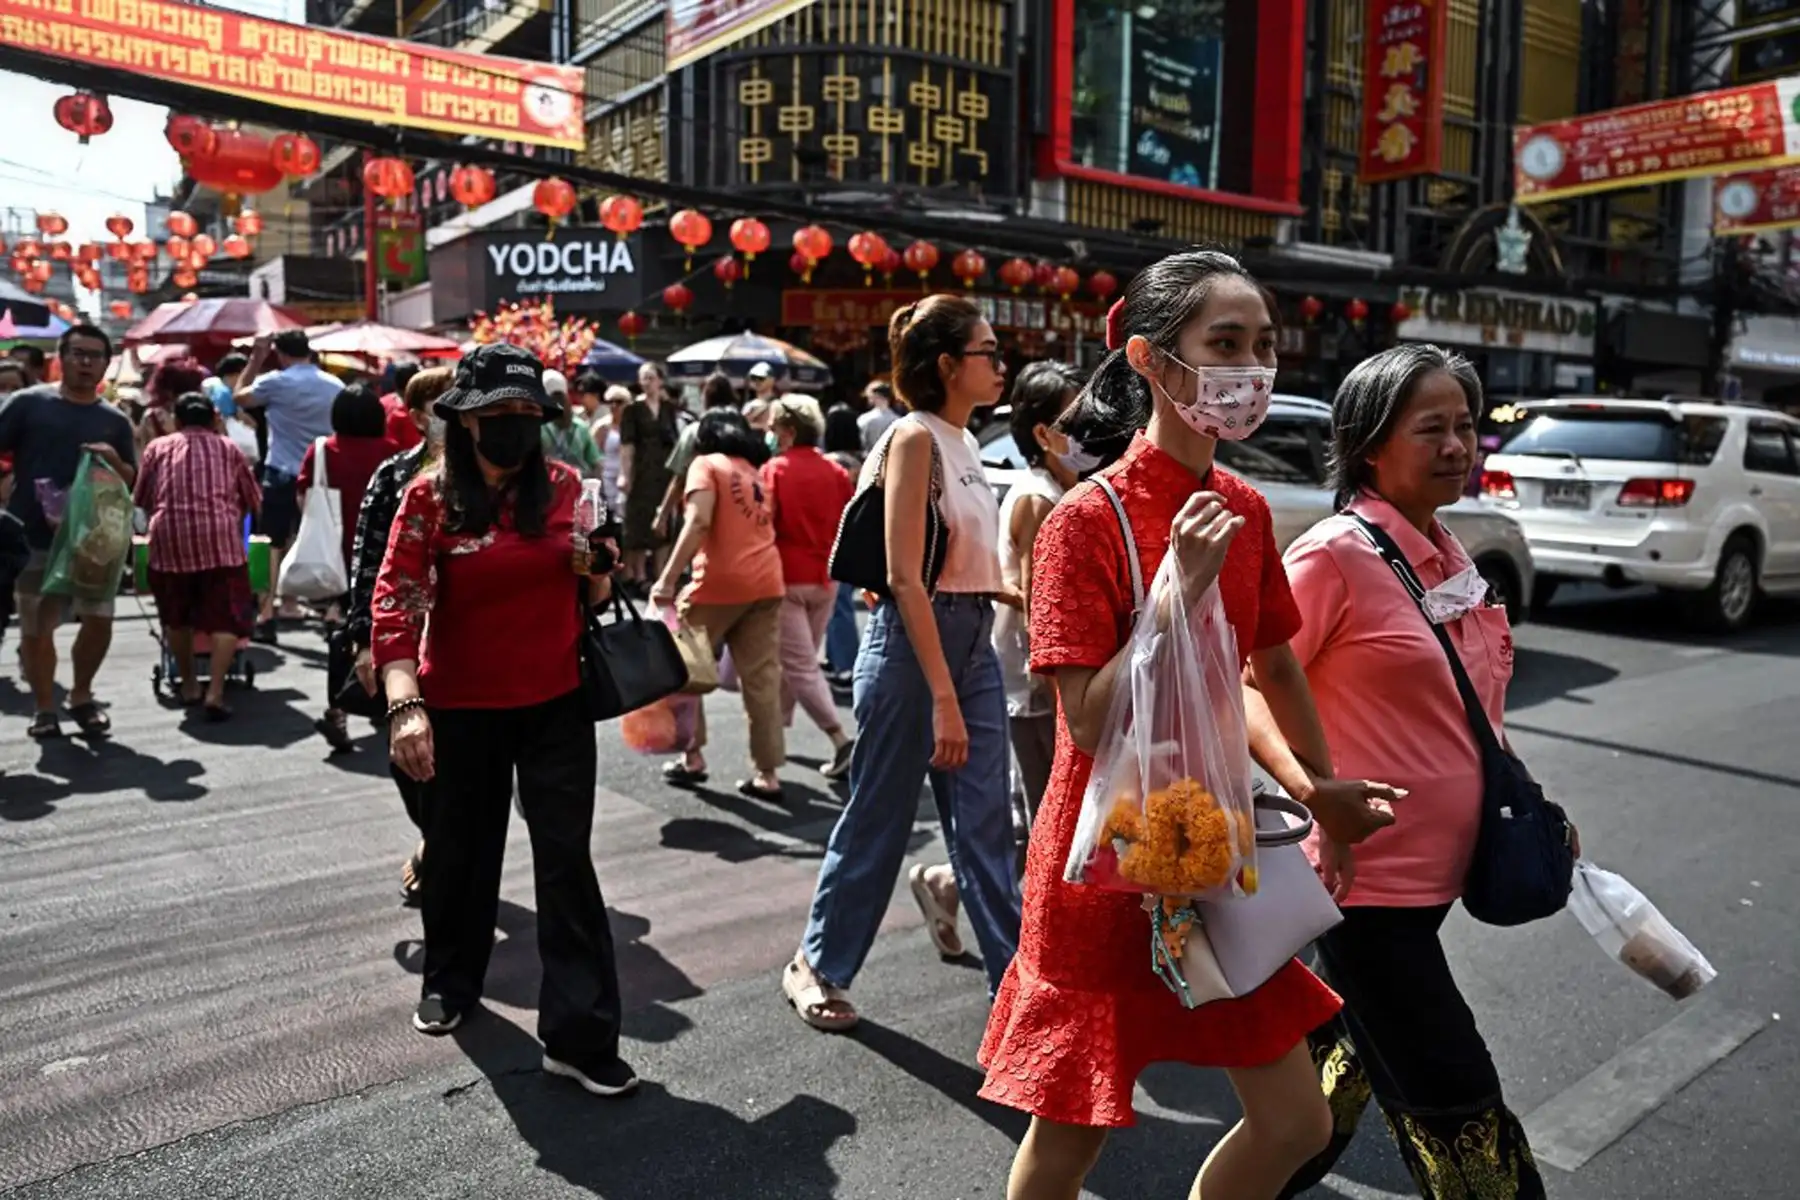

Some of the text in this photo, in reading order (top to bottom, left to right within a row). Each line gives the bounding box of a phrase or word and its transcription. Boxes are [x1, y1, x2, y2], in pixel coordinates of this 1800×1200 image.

[422, 57, 519, 94] เยาวราช
[421, 89, 520, 127] เยาวราช
[487, 241, 634, 275] YODCHA
